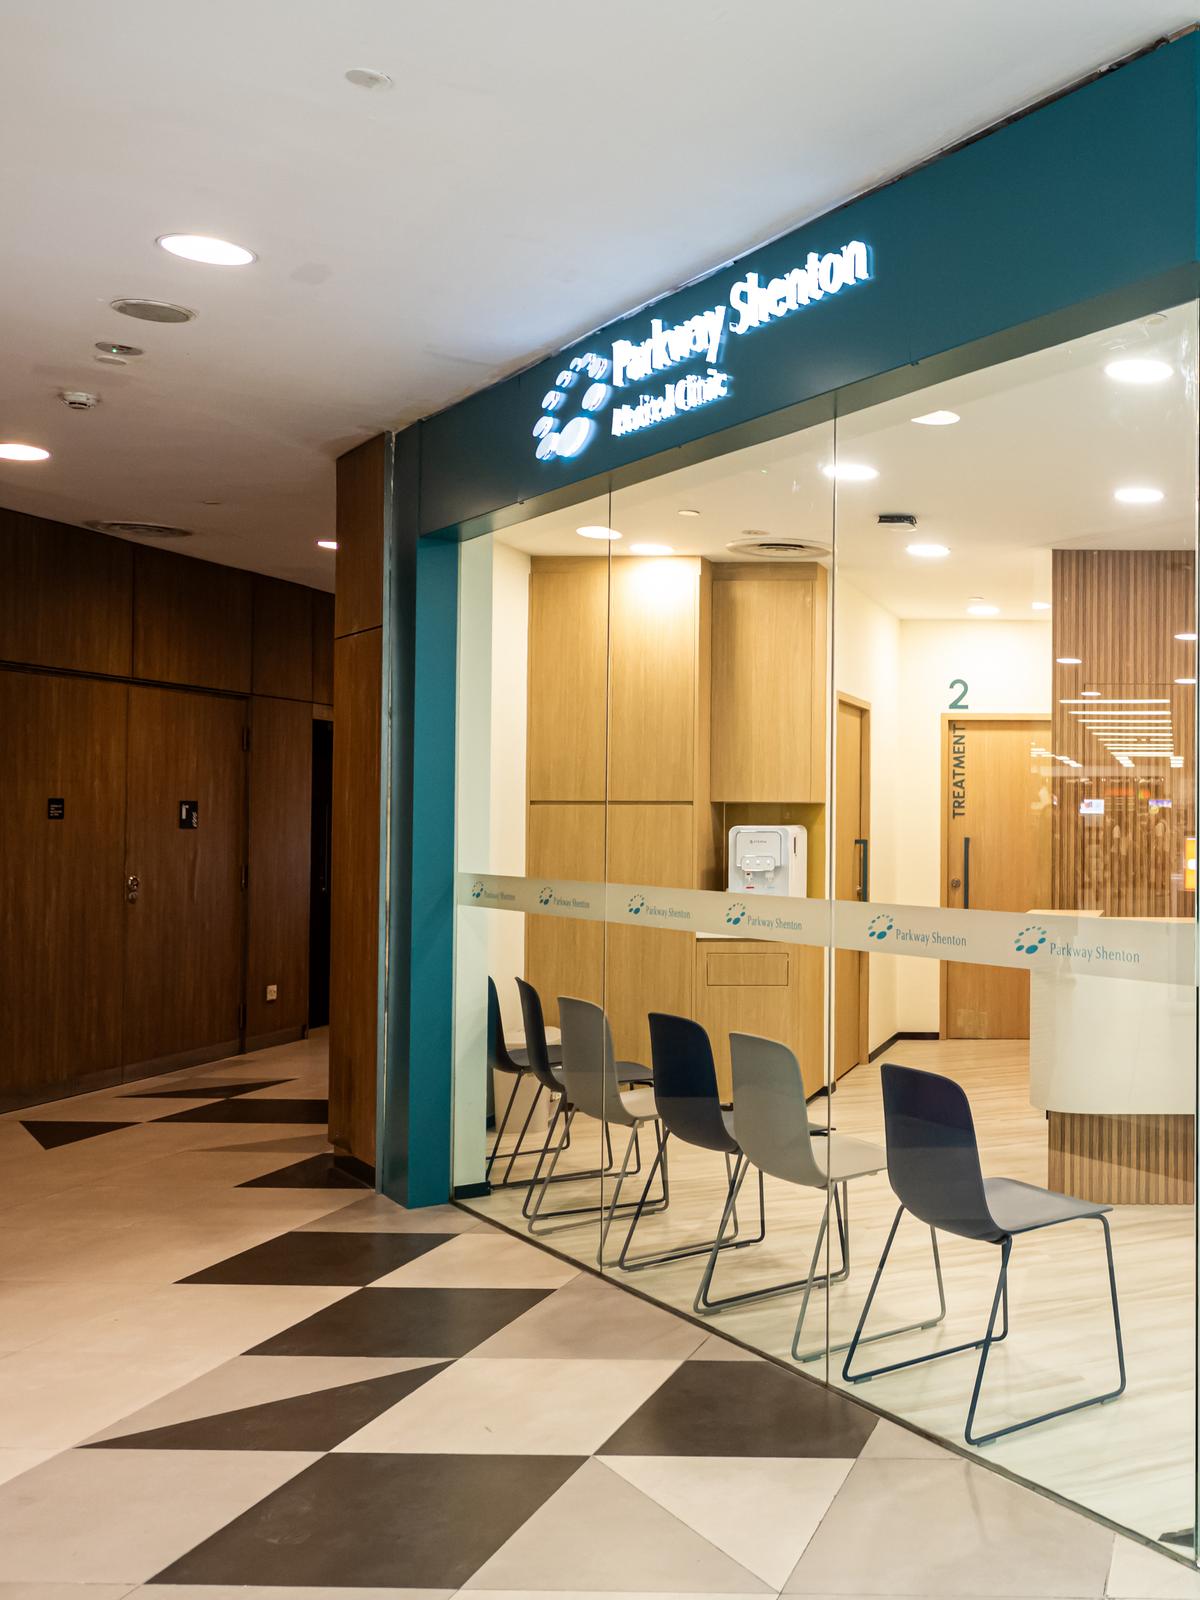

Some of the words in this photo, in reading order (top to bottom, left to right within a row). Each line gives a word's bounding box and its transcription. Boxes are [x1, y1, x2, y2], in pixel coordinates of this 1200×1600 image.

[612, 305, 726, 387] Parkway
[730, 240, 870, 334] Shenton
[948, 679, 969, 709] 2
[952, 723, 966, 820] TREATMENT
[645, 905, 667, 919] Parkway
[668, 907, 691, 920] Shenton
[747, 914, 774, 930] Parkway
[775, 917, 803, 932] Shenton
[895, 928, 930, 945] Parkway
[931, 930, 967, 947] Shenton
[1049, 942, 1093, 963] Parkway
[1095, 945, 1140, 963] Shenton
